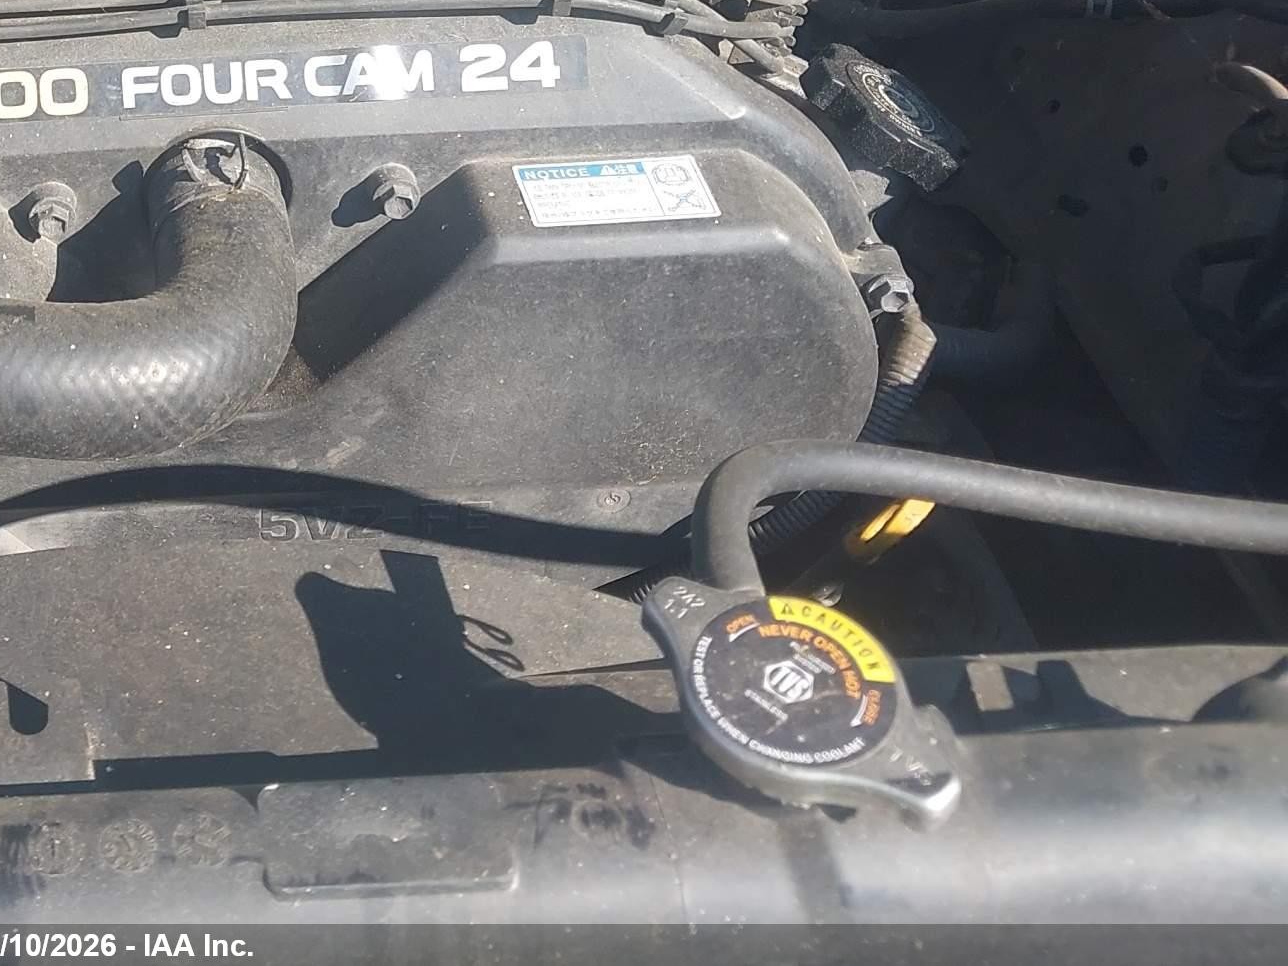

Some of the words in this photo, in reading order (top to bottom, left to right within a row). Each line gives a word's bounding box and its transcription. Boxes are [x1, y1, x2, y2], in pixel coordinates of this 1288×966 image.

[121, 58, 293, 110] FOUR
[303, 46, 436, 99] CAM
[459, 40, 562, 93] 24
[523, 167, 590, 181] NOTICE
[726, 614, 757, 635] OPEN
[800, 604, 881, 671] CAUTION
[695, 636, 713, 659] TEST
[758, 622, 813, 644] NEVER
[813, 635, 853, 671] OPEN
[841, 670, 863, 700] HOT
[693, 675, 722, 718] REPLACE
[717, 716, 752, 745] WHEN
[748, 738, 813, 764] CHANGING
[813, 737, 866, 764] COOLANT
